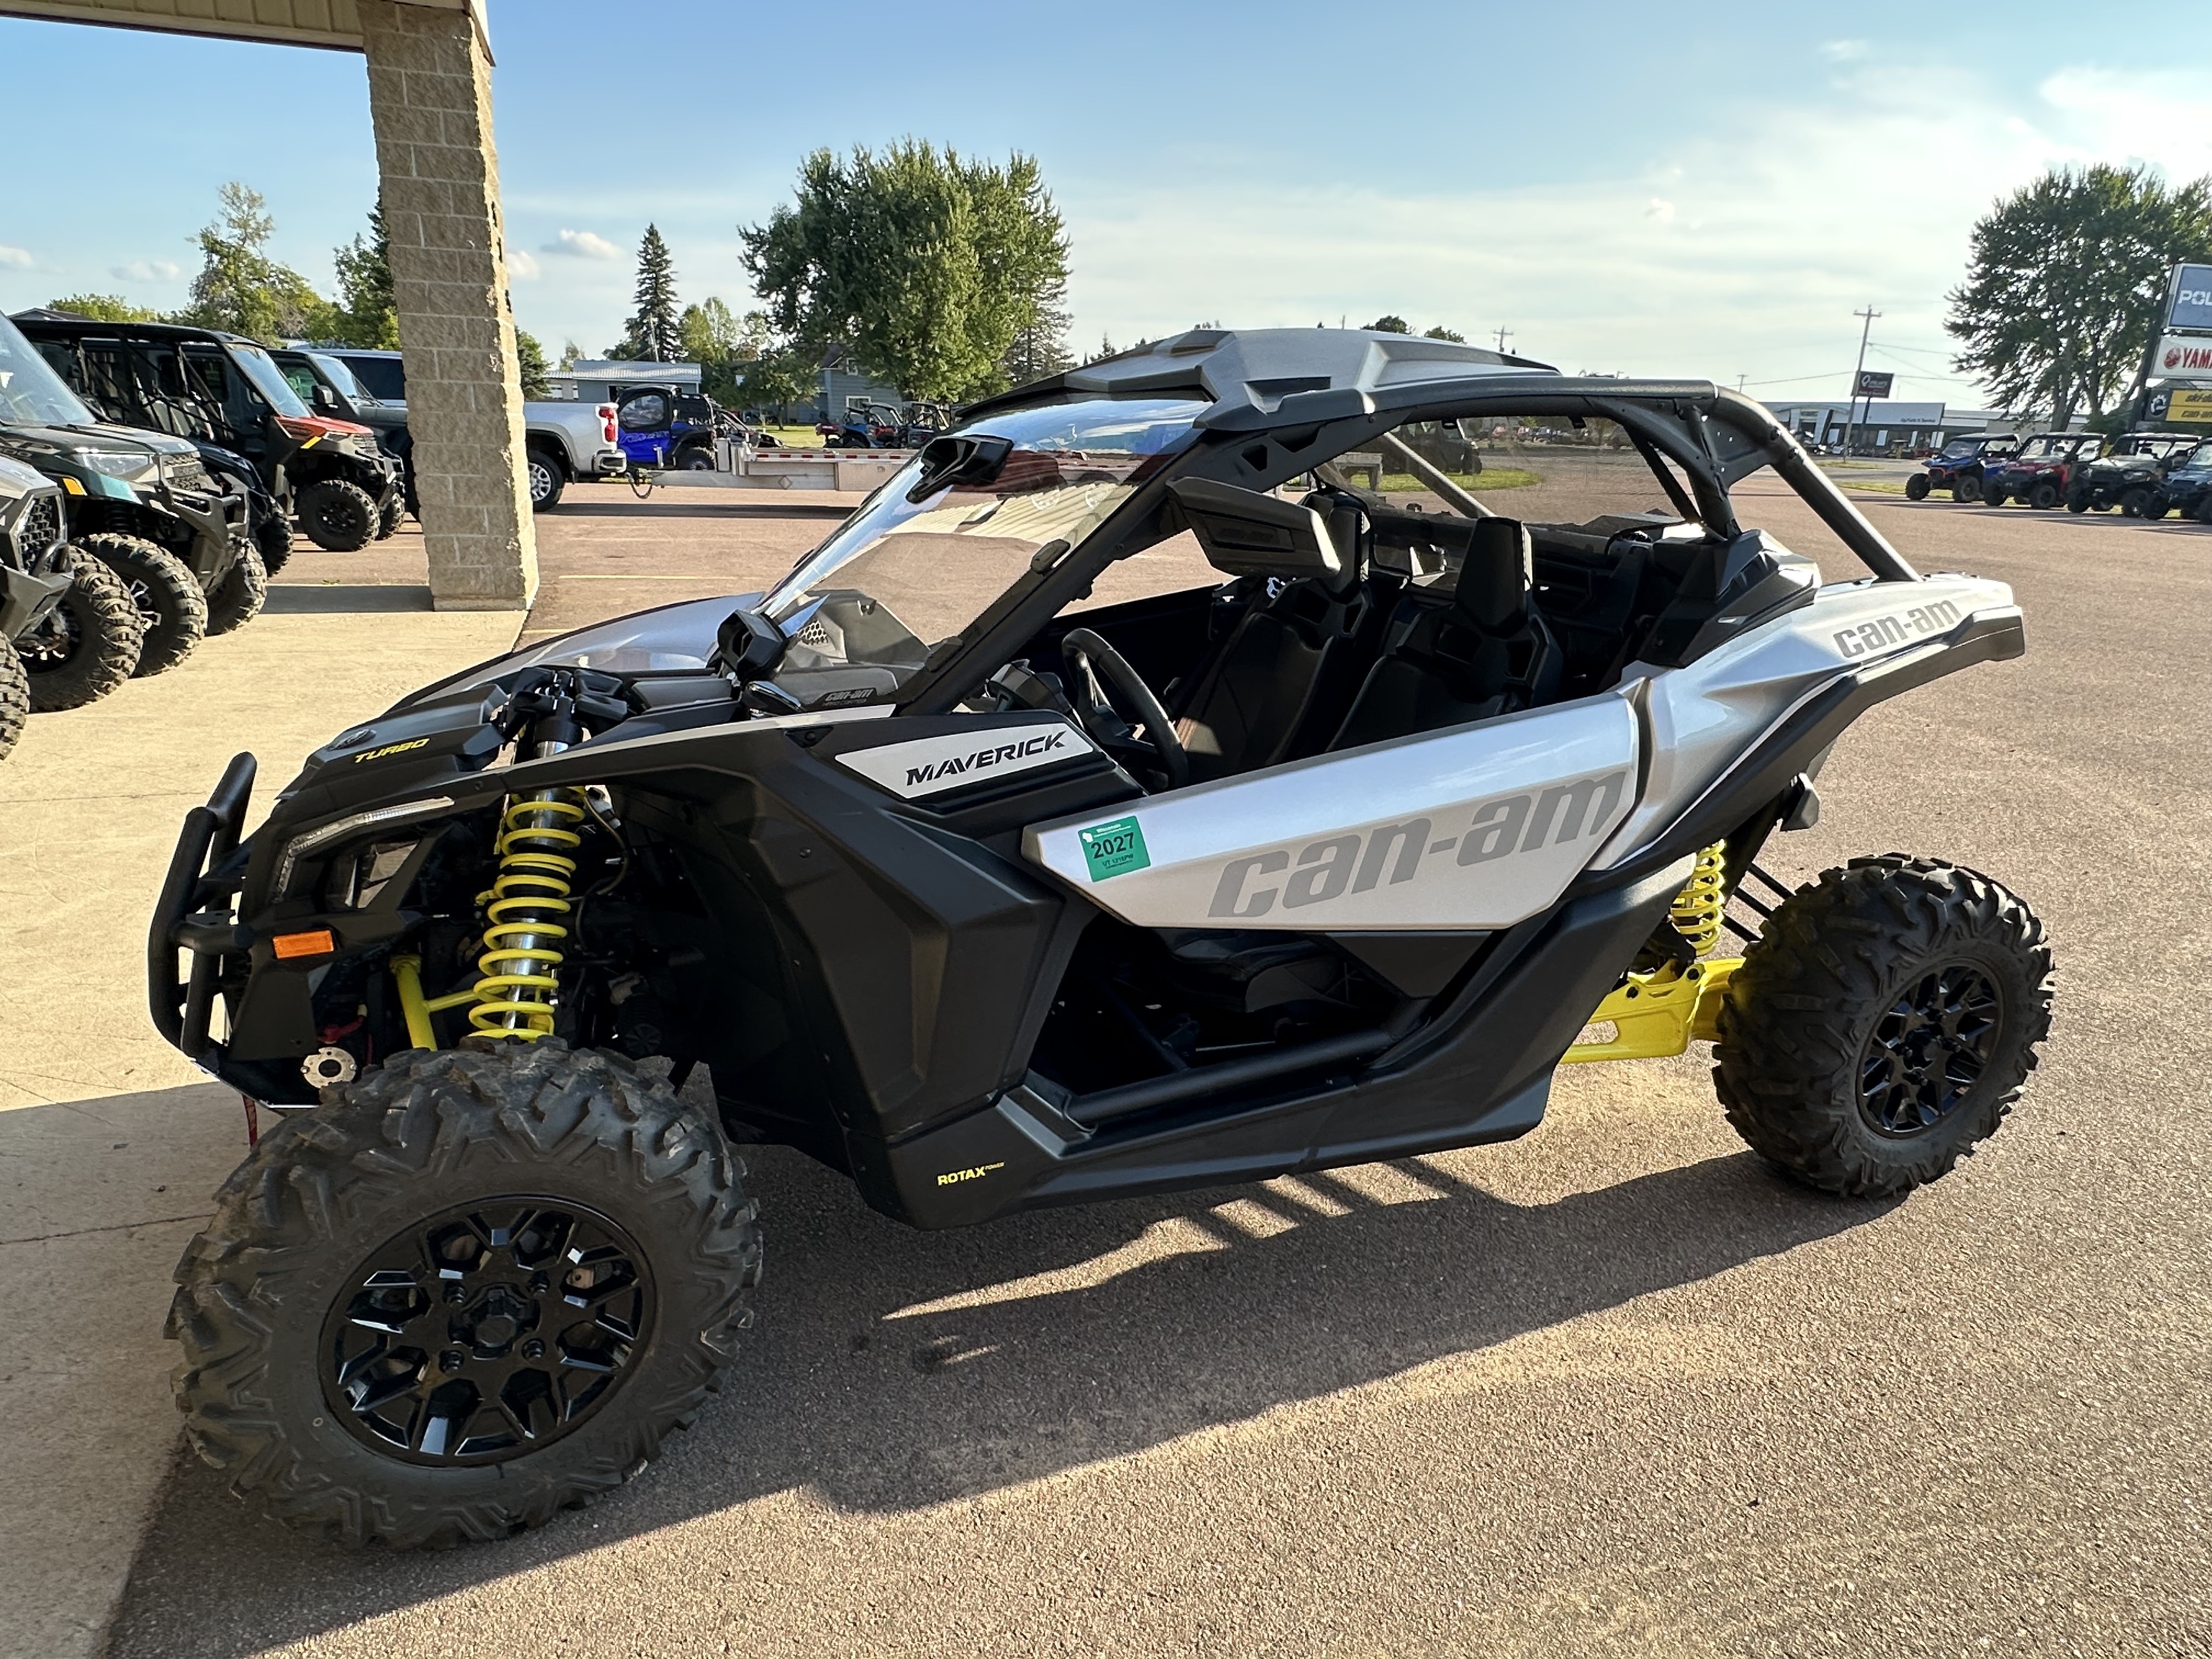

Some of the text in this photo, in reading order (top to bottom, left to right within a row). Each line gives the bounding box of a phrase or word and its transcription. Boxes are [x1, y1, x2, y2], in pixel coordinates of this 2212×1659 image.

[2178, 290, 2212, 306] POL
[2182, 348, 2212, 369] YAM
[1833, 600, 1962, 658] can-am
[825, 689, 873, 701] can-am
[355, 738, 430, 763] TURBO
[906, 731, 1066, 786] MAVERICK
[1091, 832, 1134, 859] 2027
[1207, 772, 1626, 917] can-am
[938, 1166, 986, 1186] ROTAX
